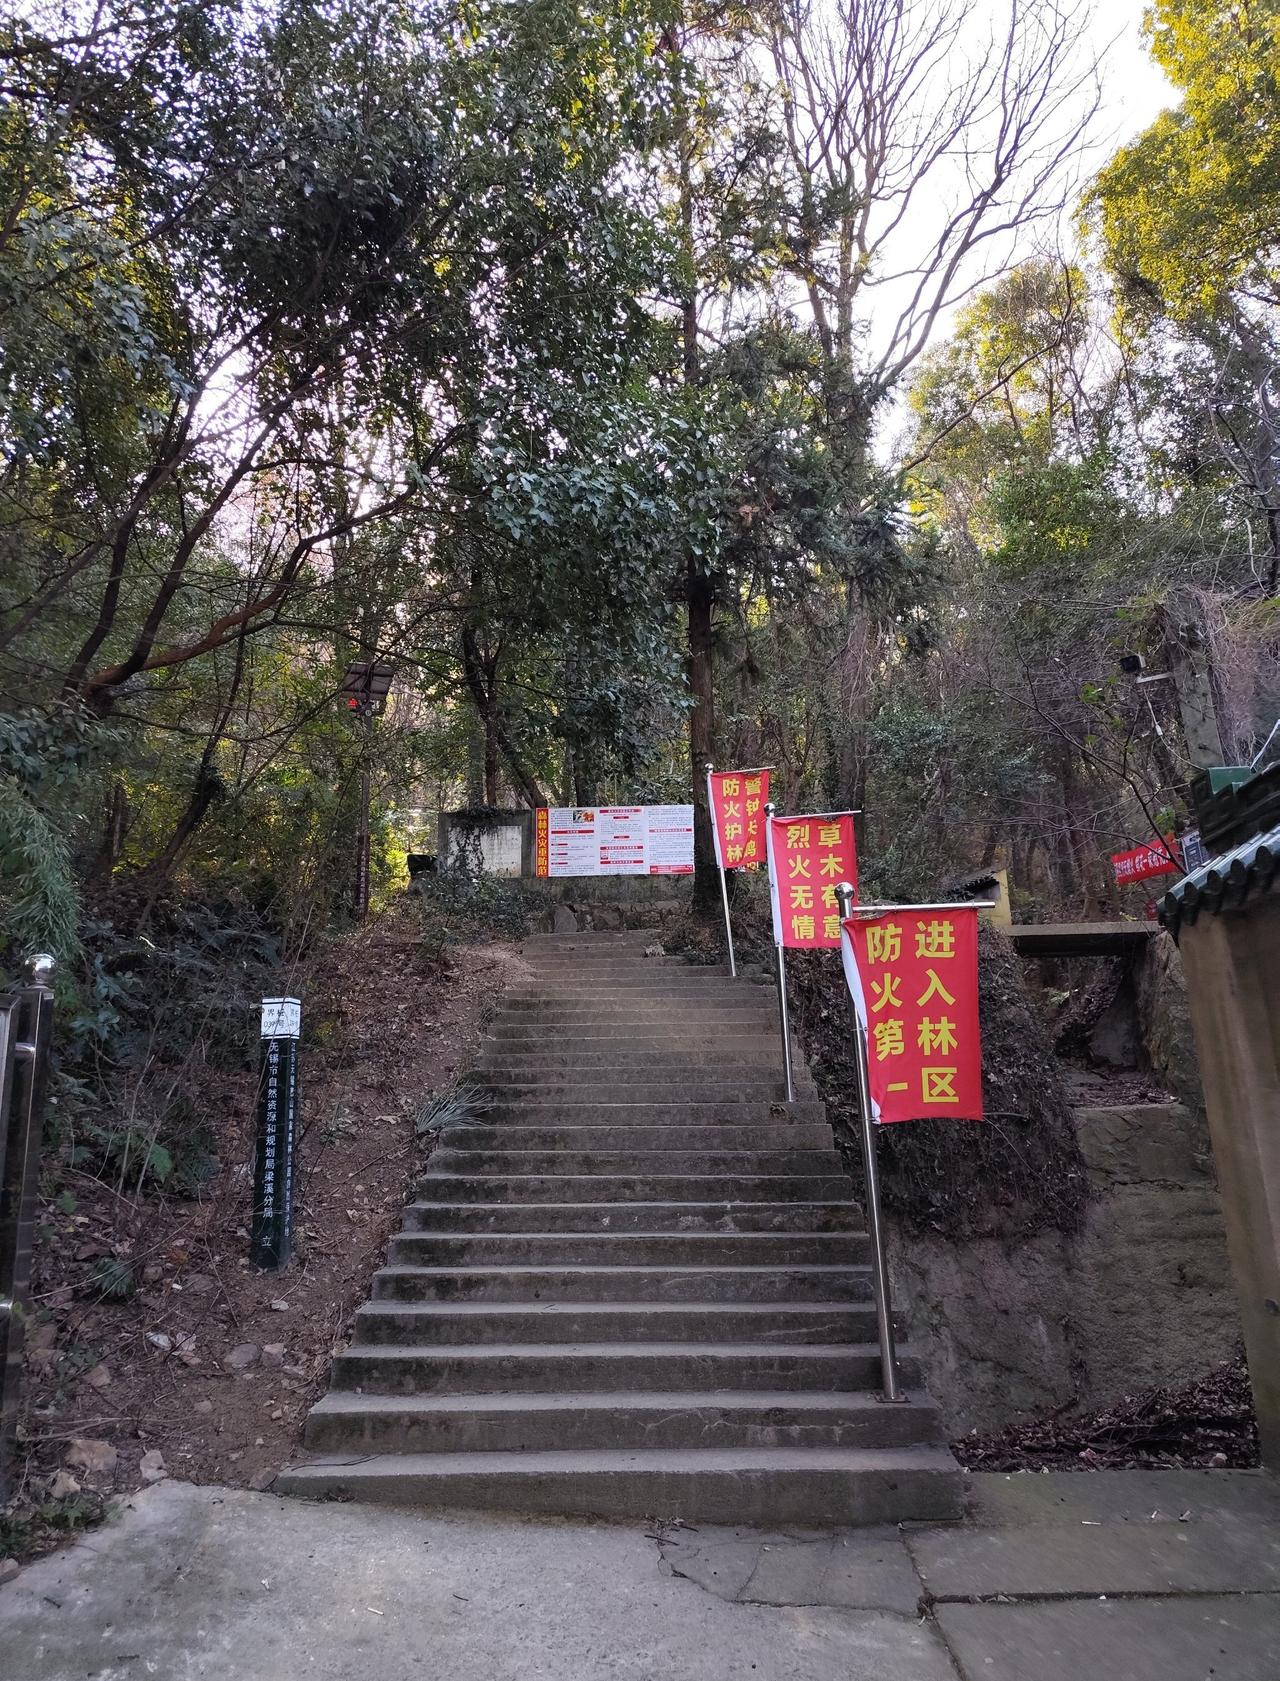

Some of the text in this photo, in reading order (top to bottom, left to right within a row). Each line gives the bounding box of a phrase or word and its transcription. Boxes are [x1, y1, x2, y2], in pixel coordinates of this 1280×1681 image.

[722, 779, 743, 862] 防火护林
[786, 824, 816, 940] 烈火无情
[817, 824, 845, 939] 草木有意
[865, 923, 909, 1093] 防火第一
[914, 920, 960, 1104] 进入林区
[261, 1042, 279, 1247] 无锡市自然资源和规划局梁溪分局 立
